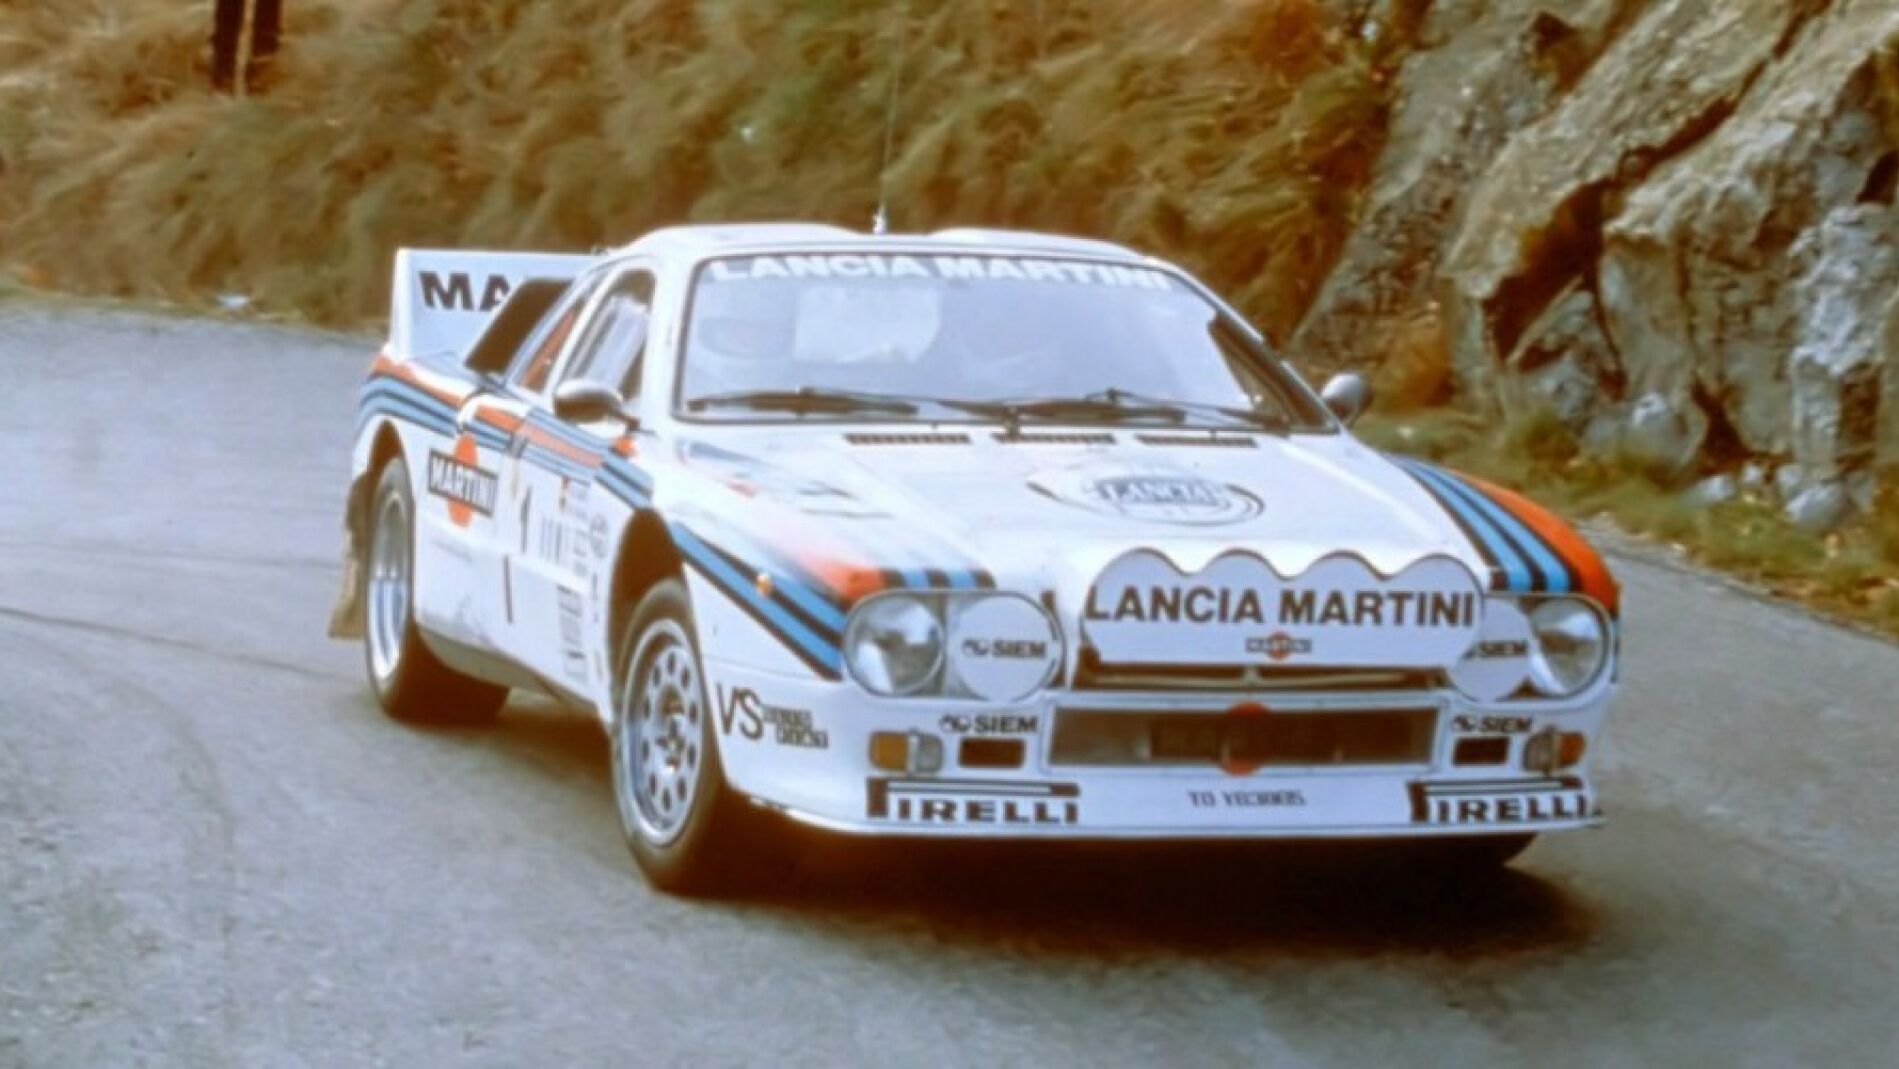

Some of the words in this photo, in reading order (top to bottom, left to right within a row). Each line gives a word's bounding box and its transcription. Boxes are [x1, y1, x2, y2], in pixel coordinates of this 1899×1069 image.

[709, 256, 930, 281] LANCIA
[933, 258, 1172, 291] MARTINI
[1085, 586, 1264, 625] LANCIA
[1279, 590, 1474, 628] MARTINI
[989, 638, 1047, 659] SIEM
[1479, 640, 1529, 658] SIEM
[716, 681, 763, 741] VS
[973, 715, 1038, 733] SIEM
[1482, 716, 1534, 733] SIEM
[866, 777, 1080, 824] PIRELLI
[1408, 777, 1588, 823] PIRELLI
